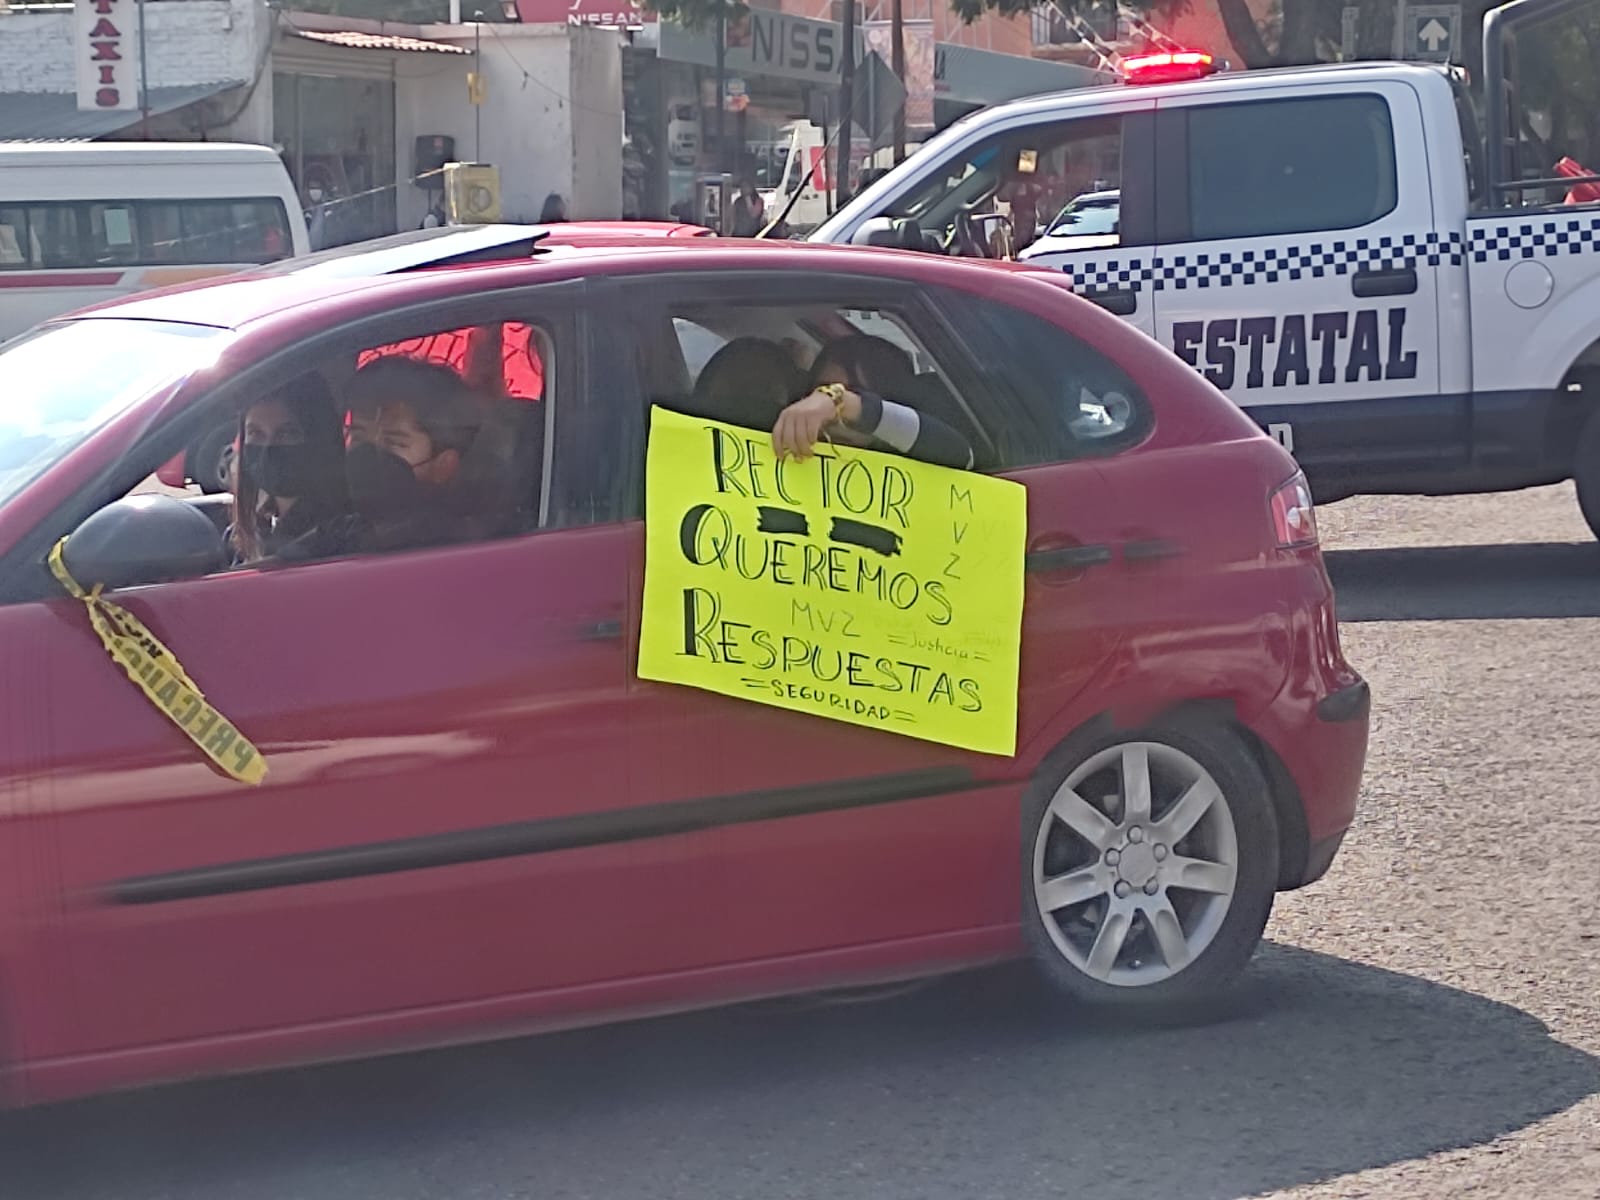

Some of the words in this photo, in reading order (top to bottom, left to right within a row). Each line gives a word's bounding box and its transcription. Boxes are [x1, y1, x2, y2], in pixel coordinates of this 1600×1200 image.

[88, 0, 122, 107] TAXIS
[751, 15, 864, 75] NISS
[1173, 307, 1417, 390] ESTATAL
[703, 427, 914, 528] RECTOR
[680, 503, 953, 626] QUEREMOS
[675, 587, 982, 712] RESPUESTAS
